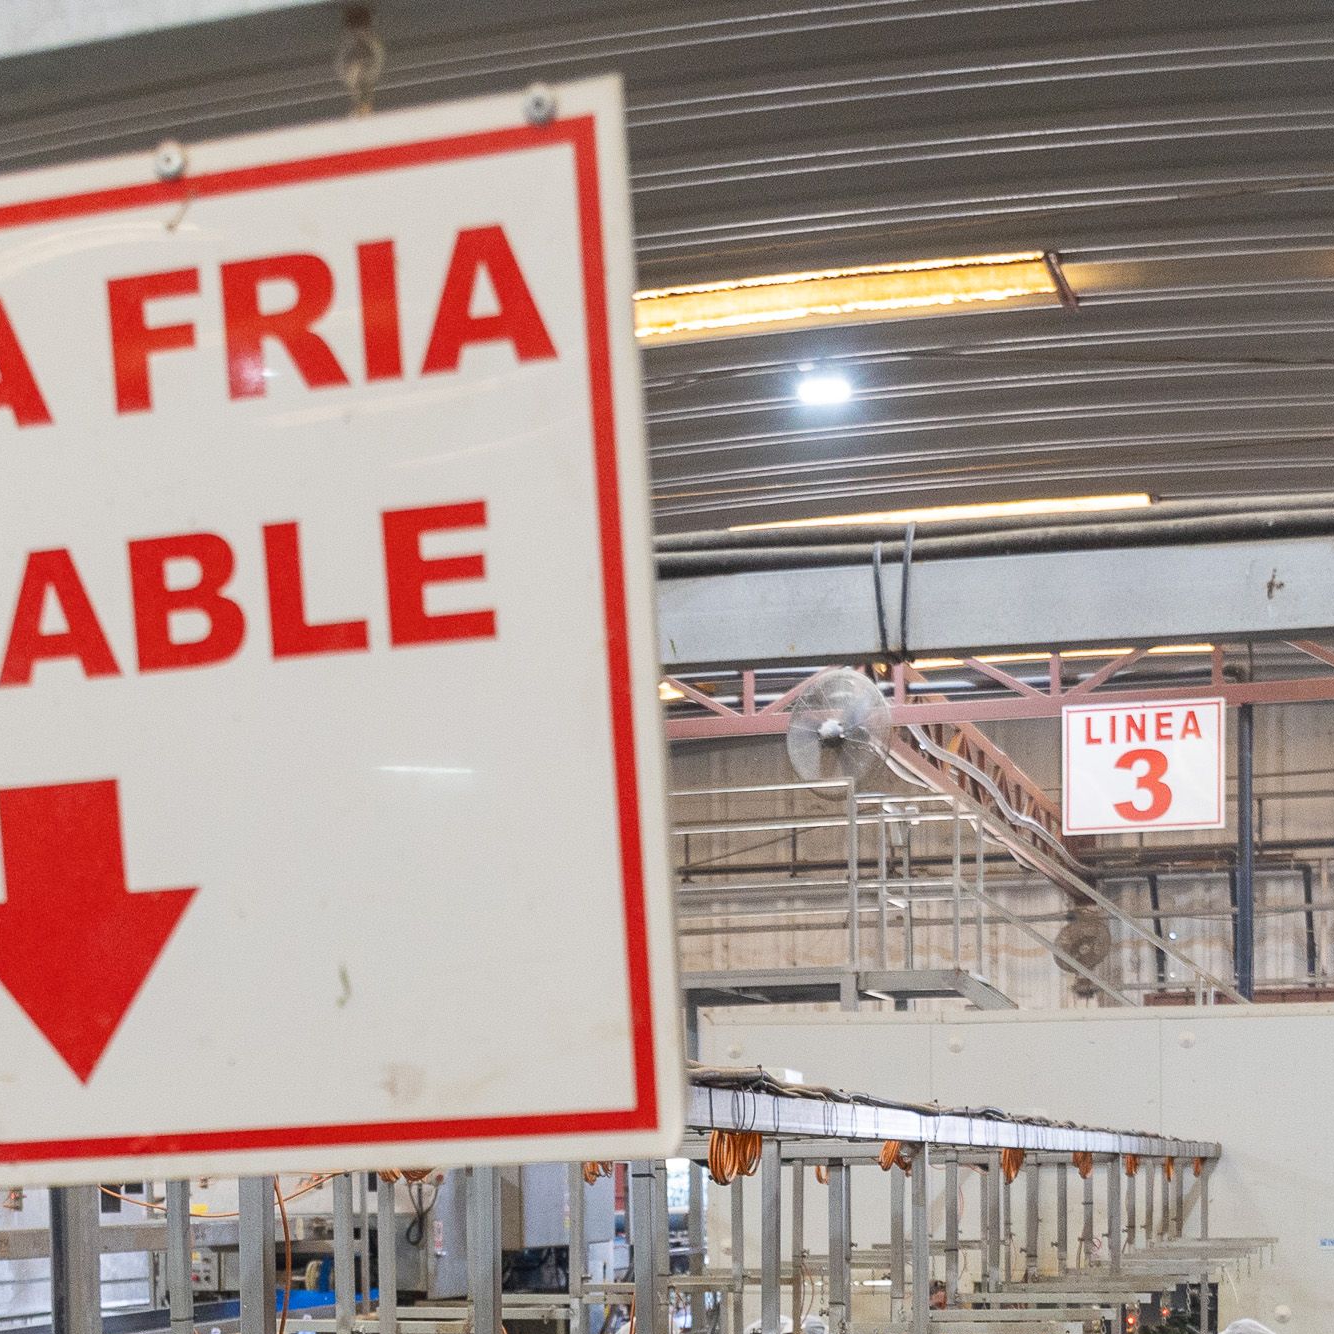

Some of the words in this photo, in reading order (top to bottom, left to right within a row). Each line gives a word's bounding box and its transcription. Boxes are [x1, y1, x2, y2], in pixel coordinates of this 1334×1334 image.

[106, 223, 558, 415] FRIA
[1085, 710, 1203, 745] LINEA
[1113, 748, 1173, 822] 3
